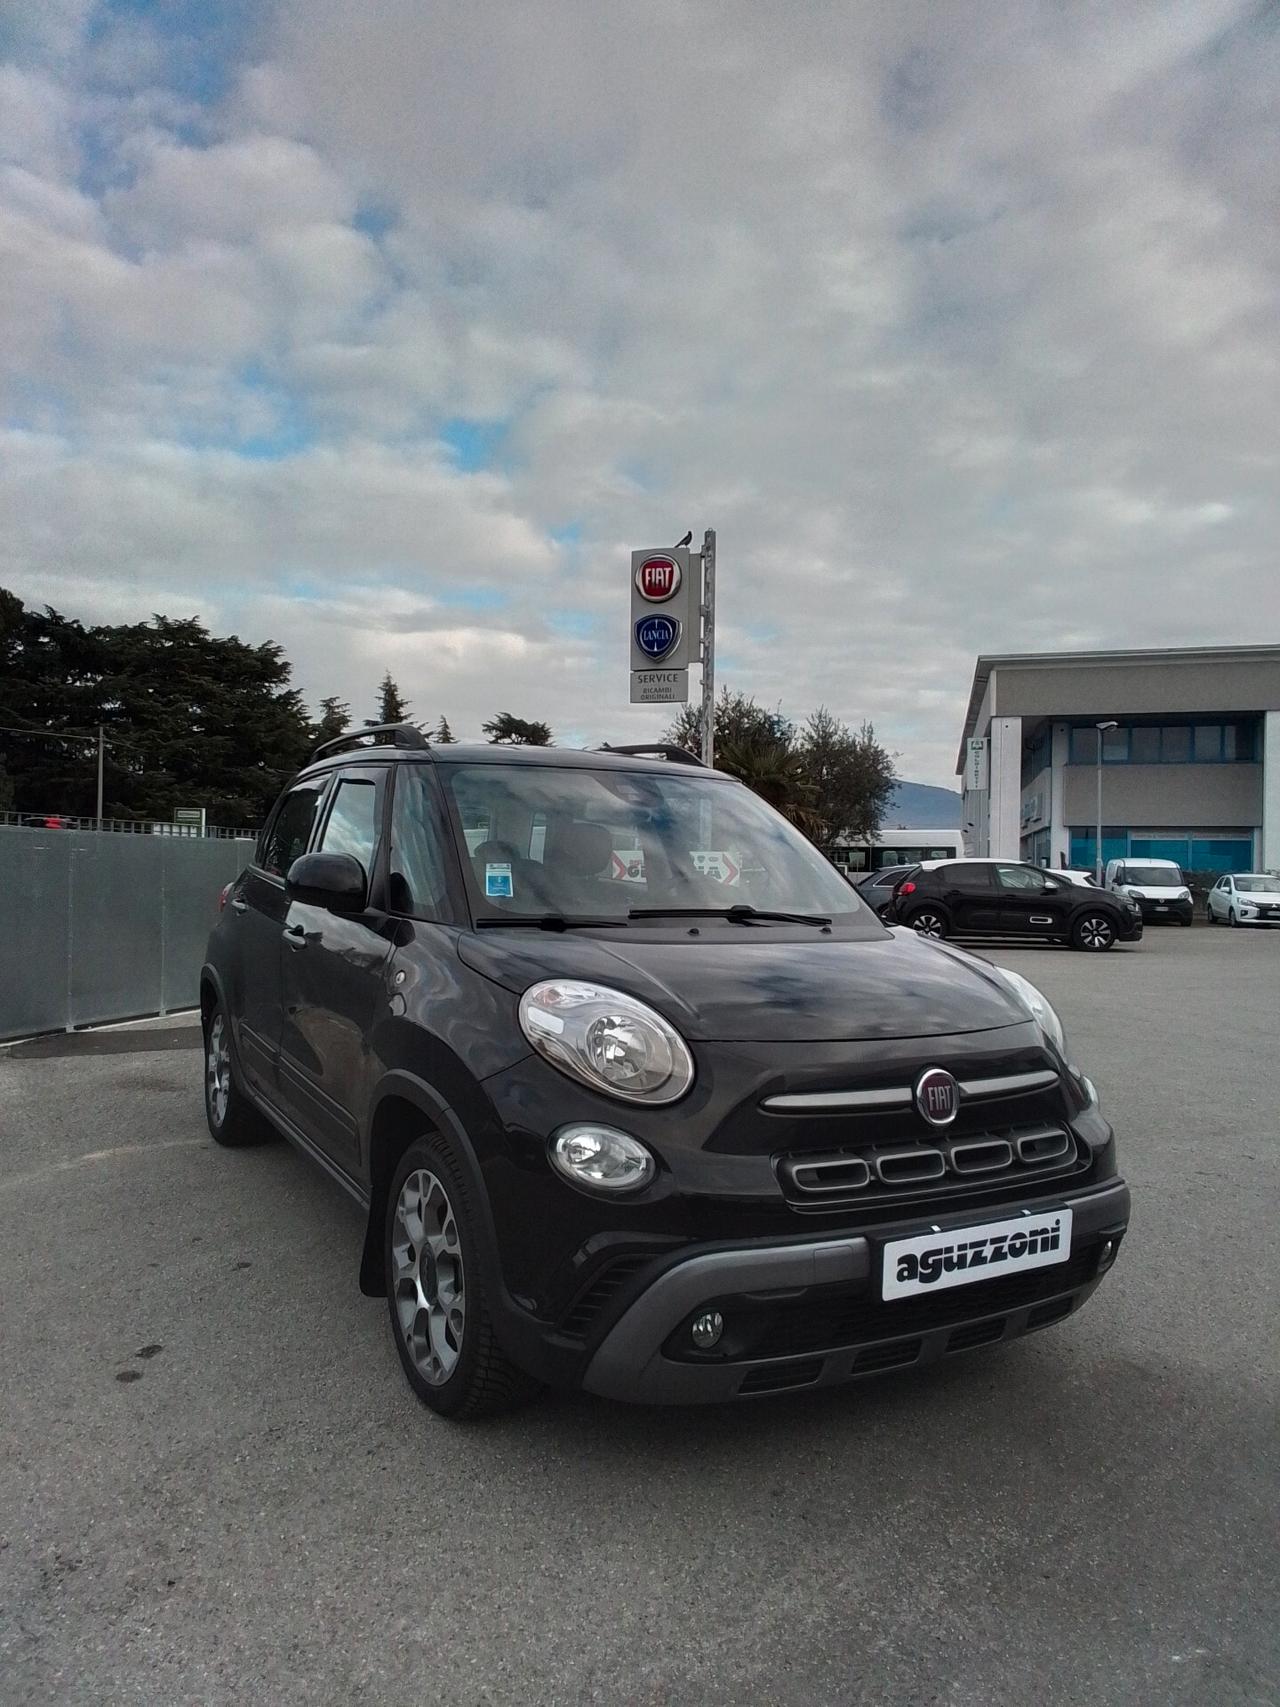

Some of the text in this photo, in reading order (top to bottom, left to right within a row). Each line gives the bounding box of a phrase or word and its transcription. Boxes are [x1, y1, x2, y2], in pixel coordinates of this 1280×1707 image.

[645, 567, 672, 588] FIAT
[643, 629, 669, 641] LANCIA
[637, 673, 679, 684] SERVICE
[643, 686, 672, 694] RICAMBI
[640, 693, 676, 701] ORIGINALI
[927, 1085, 951, 1110] FIAT
[896, 1218, 1061, 1284] aguzzoni
